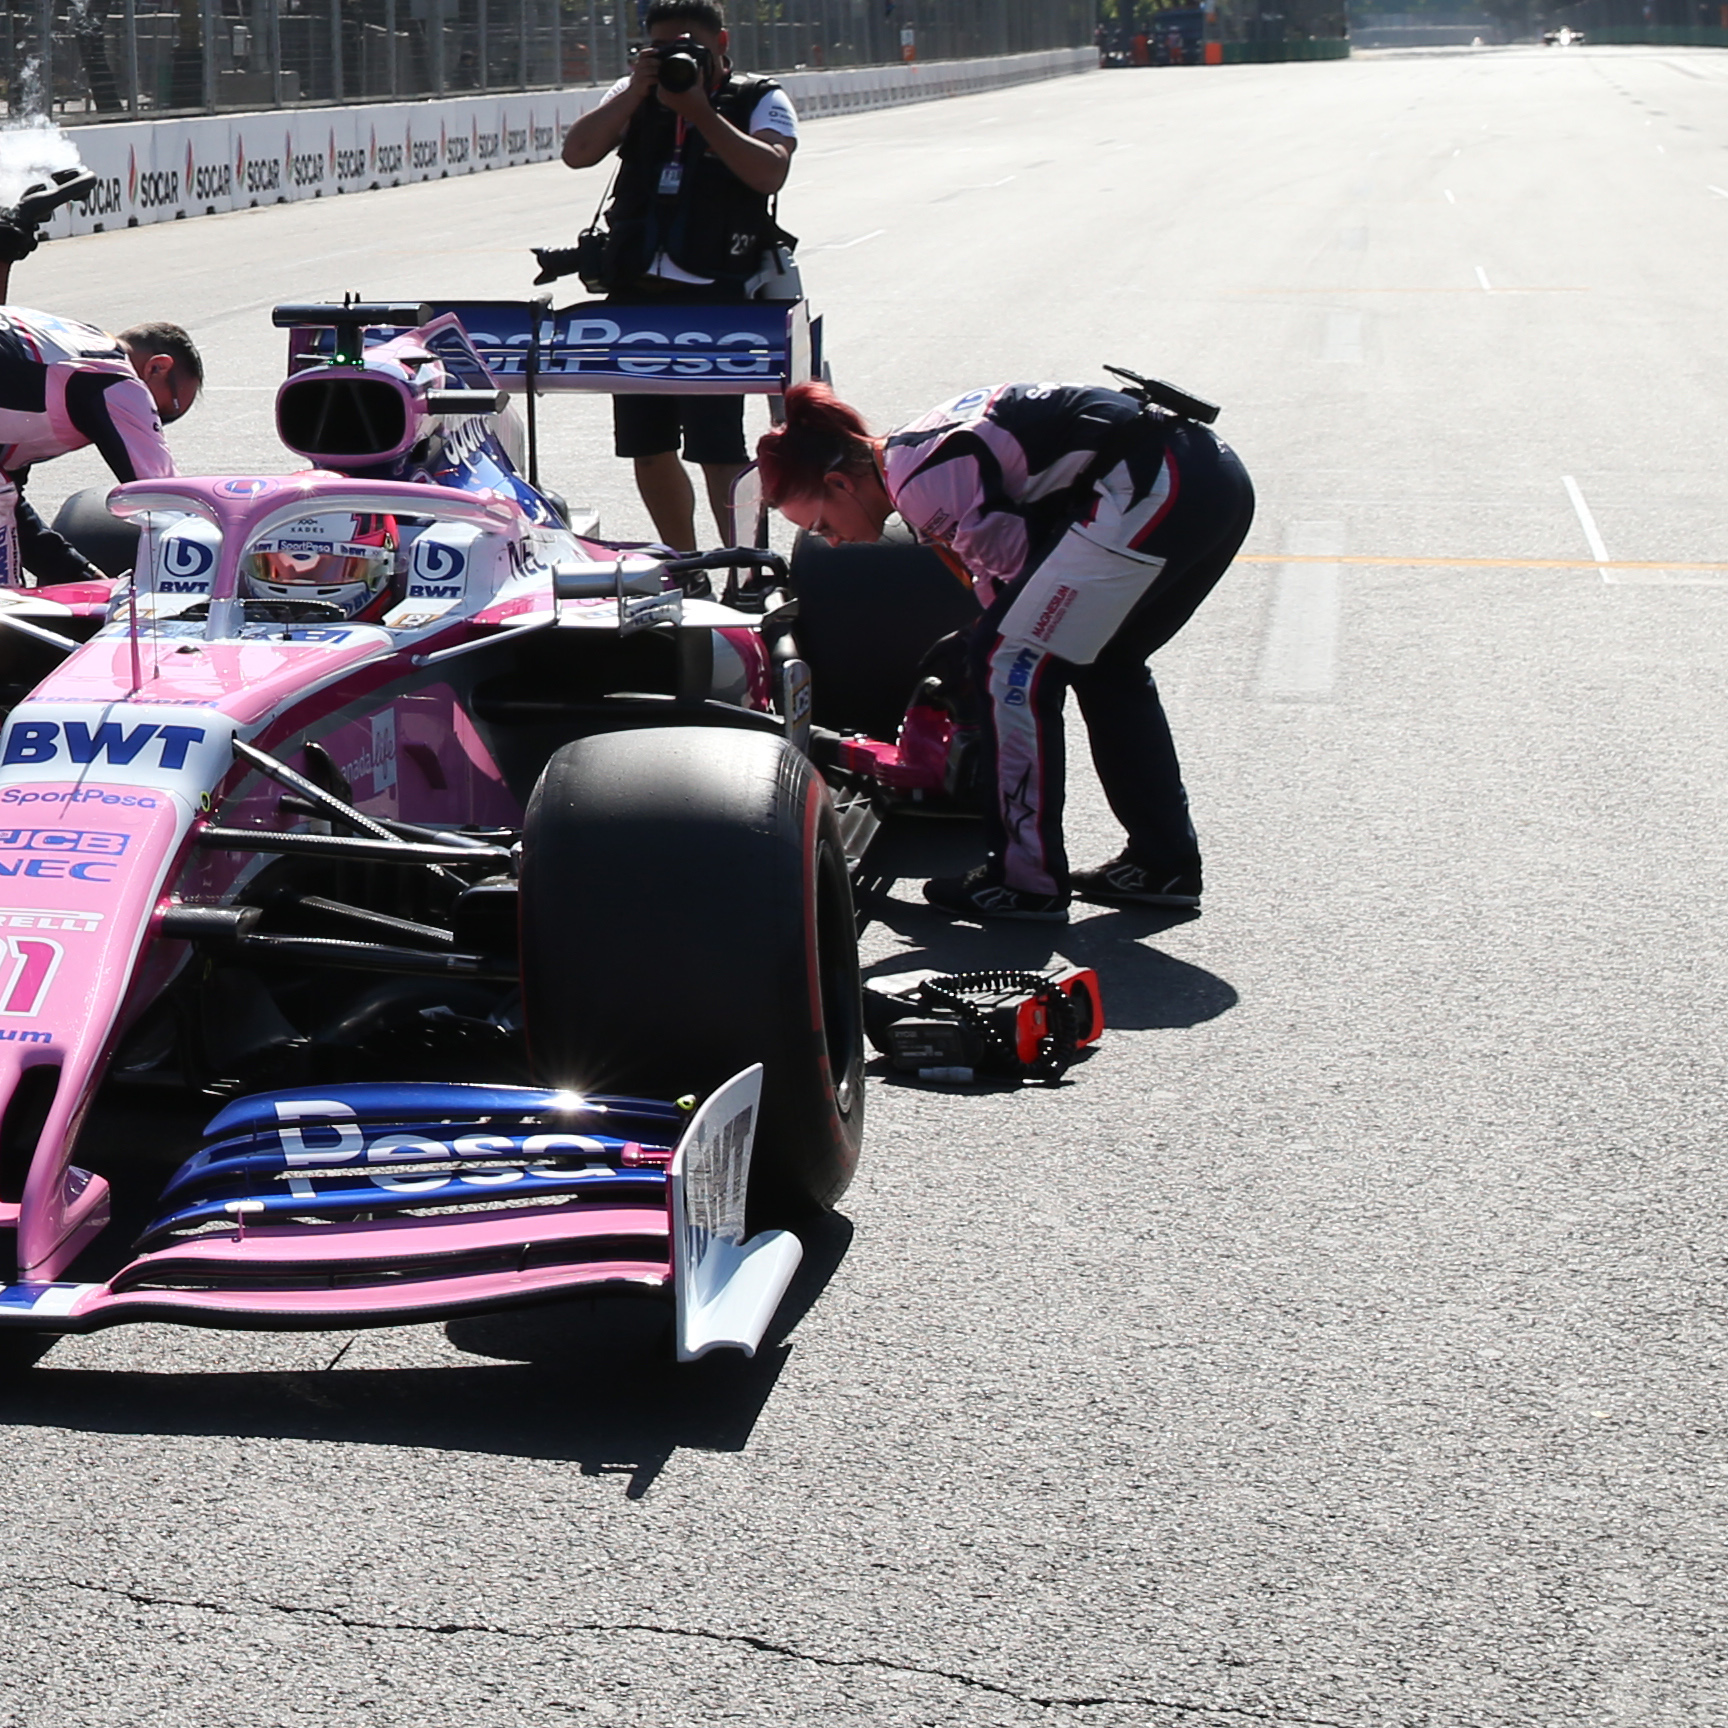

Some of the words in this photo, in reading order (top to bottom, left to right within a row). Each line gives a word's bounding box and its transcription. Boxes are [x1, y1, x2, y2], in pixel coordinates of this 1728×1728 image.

[294, 152, 324, 186] SOCAR
[337, 148, 366, 180] SOCAR
[378, 144, 403, 173] SOCAR
[413, 140, 438, 169] SOCAR
[140, 170, 179, 209] SOCAR
[196, 163, 232, 200] SOCAR
[247, 159, 281, 193] SOCAR
[258, 542, 273, 553] BWT
[280, 540, 331, 554] SportPesa
[347, 546, 366, 558] BWT
[159, 581, 210, 593] BWT
[409, 585, 461, 599] BWT
[1031, 585, 1071, 640] MAGNESIUM
[1007, 647, 1040, 687] BWT
[1, 721, 207, 770] BWT
[0, 789, 157, 810] SportPesa
[274, 1100, 618, 1200] Pesa
